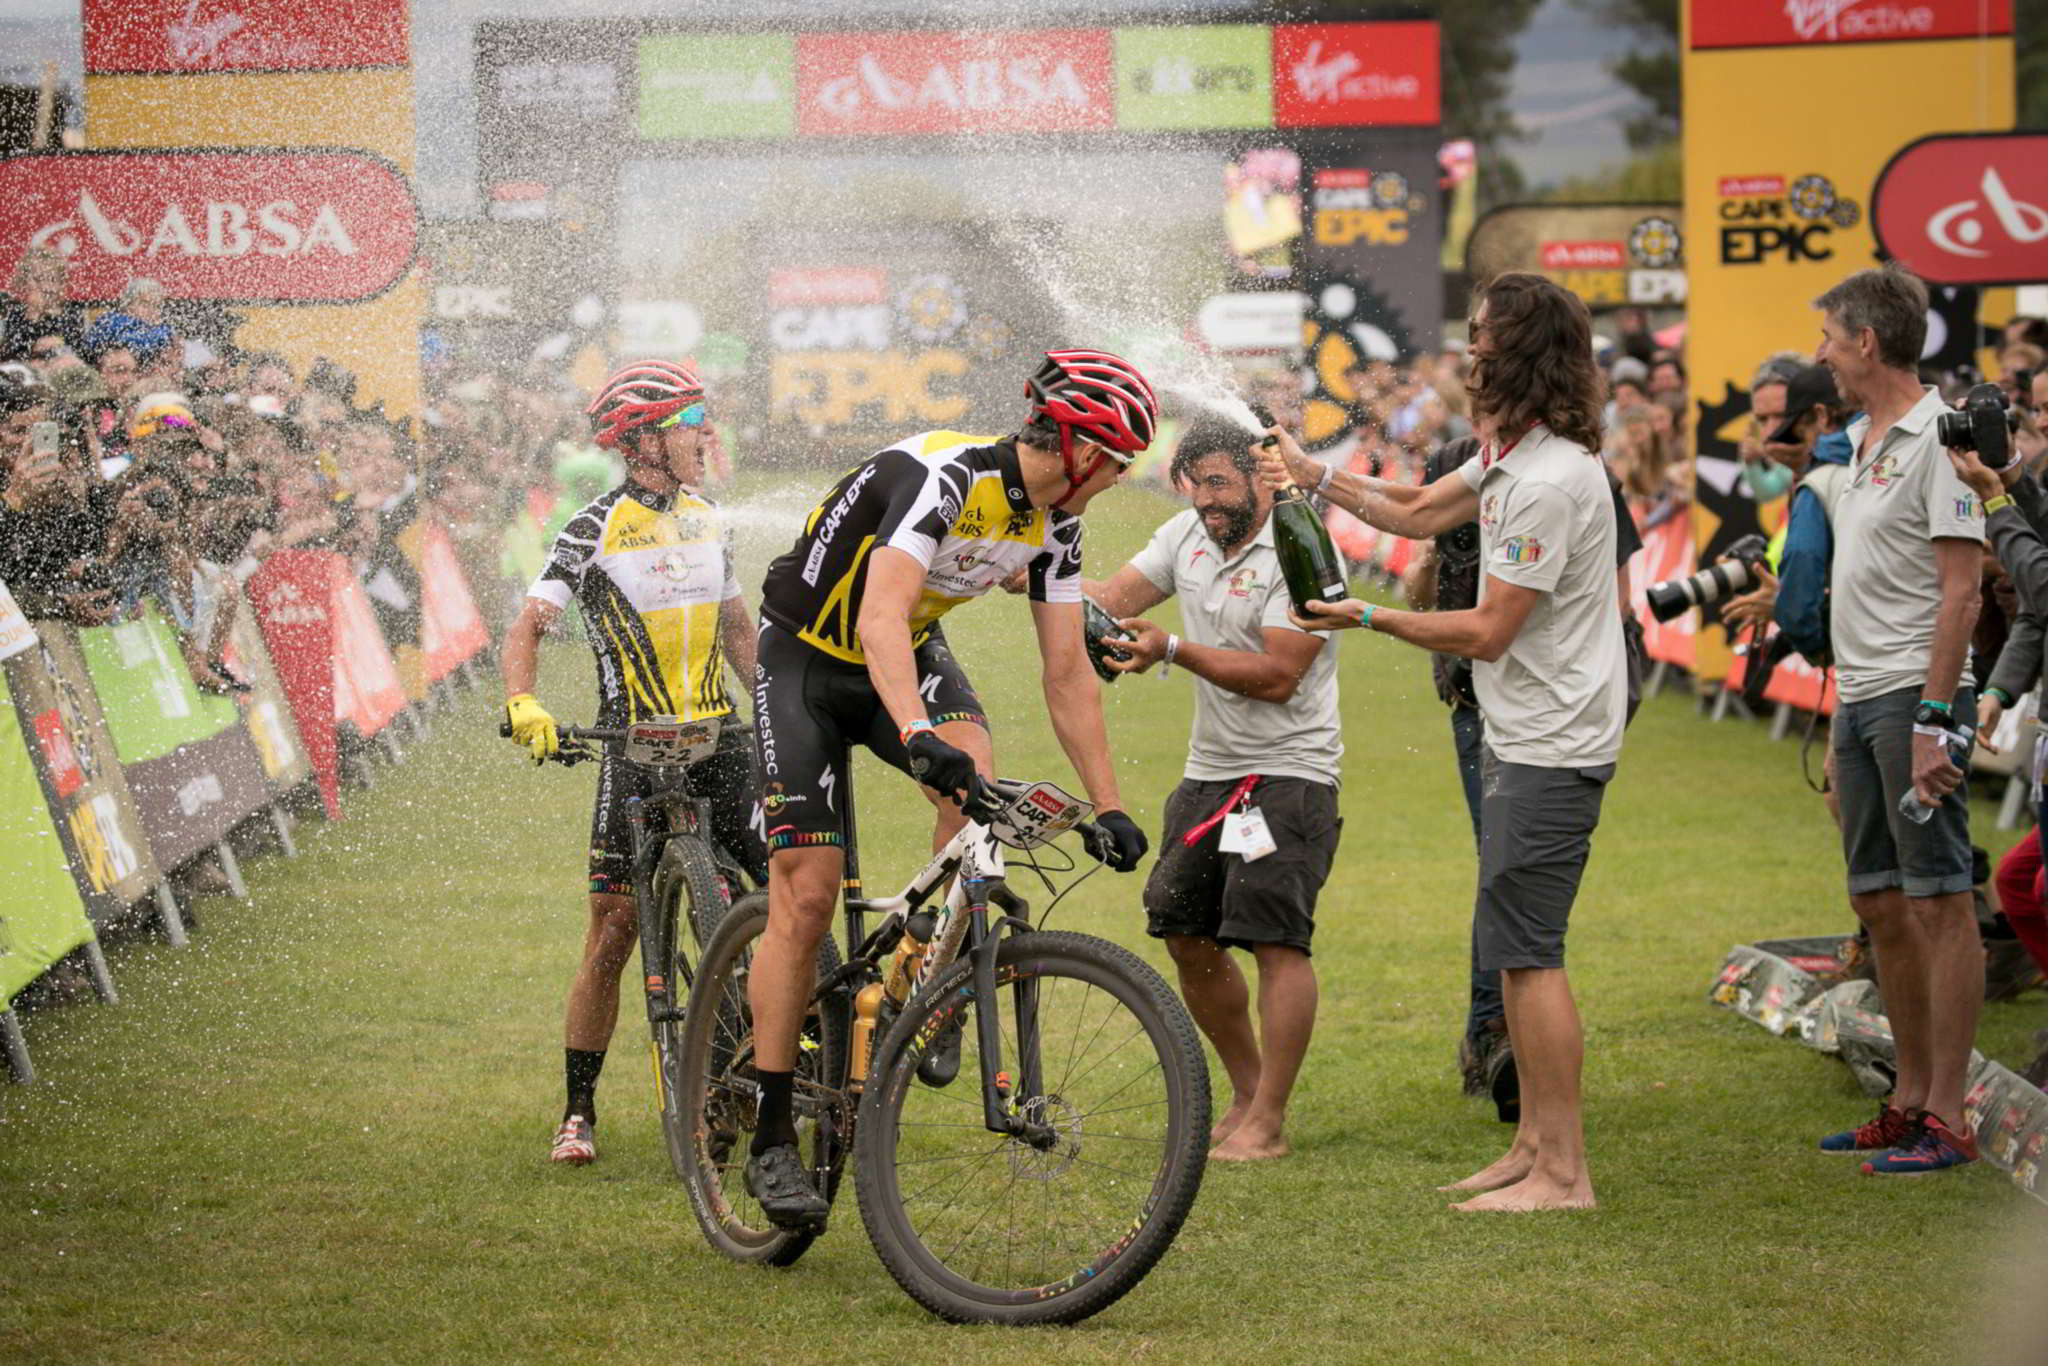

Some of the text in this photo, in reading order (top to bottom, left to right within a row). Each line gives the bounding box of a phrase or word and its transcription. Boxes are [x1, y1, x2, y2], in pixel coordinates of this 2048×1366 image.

[918, 63, 1090, 108] ABSA
[148, 201, 356, 258] ABSA
[1721, 224, 1833, 264] EPIC
[819, 497, 851, 544] CAPE
[845, 463, 877, 506] EPIC
[957, 523, 985, 537] ABS
[756, 681, 780, 776] Investec
[1016, 800, 1053, 827] CAPE
